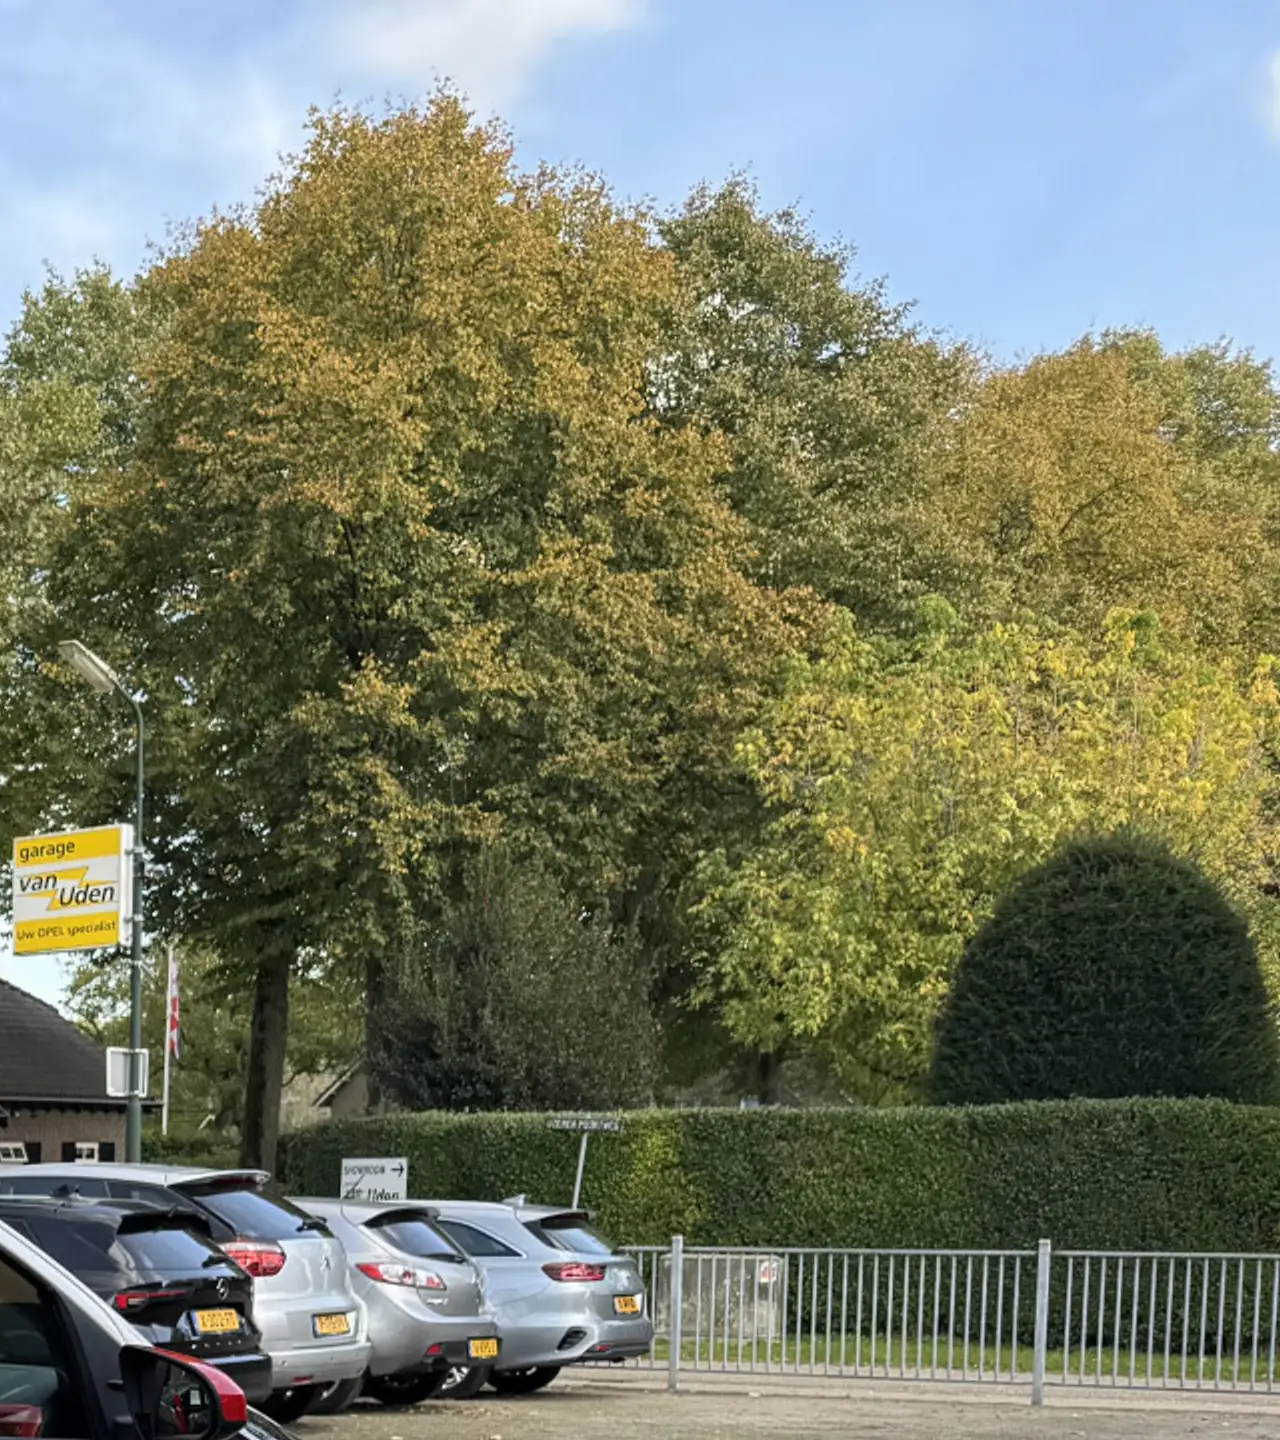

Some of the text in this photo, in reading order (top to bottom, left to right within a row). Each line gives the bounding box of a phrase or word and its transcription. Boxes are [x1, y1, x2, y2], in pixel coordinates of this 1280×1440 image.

[19, 841, 76, 862] garage
[19, 874, 115, 907] van Uden
[16, 920, 117, 941] Uw OPEL specialist
